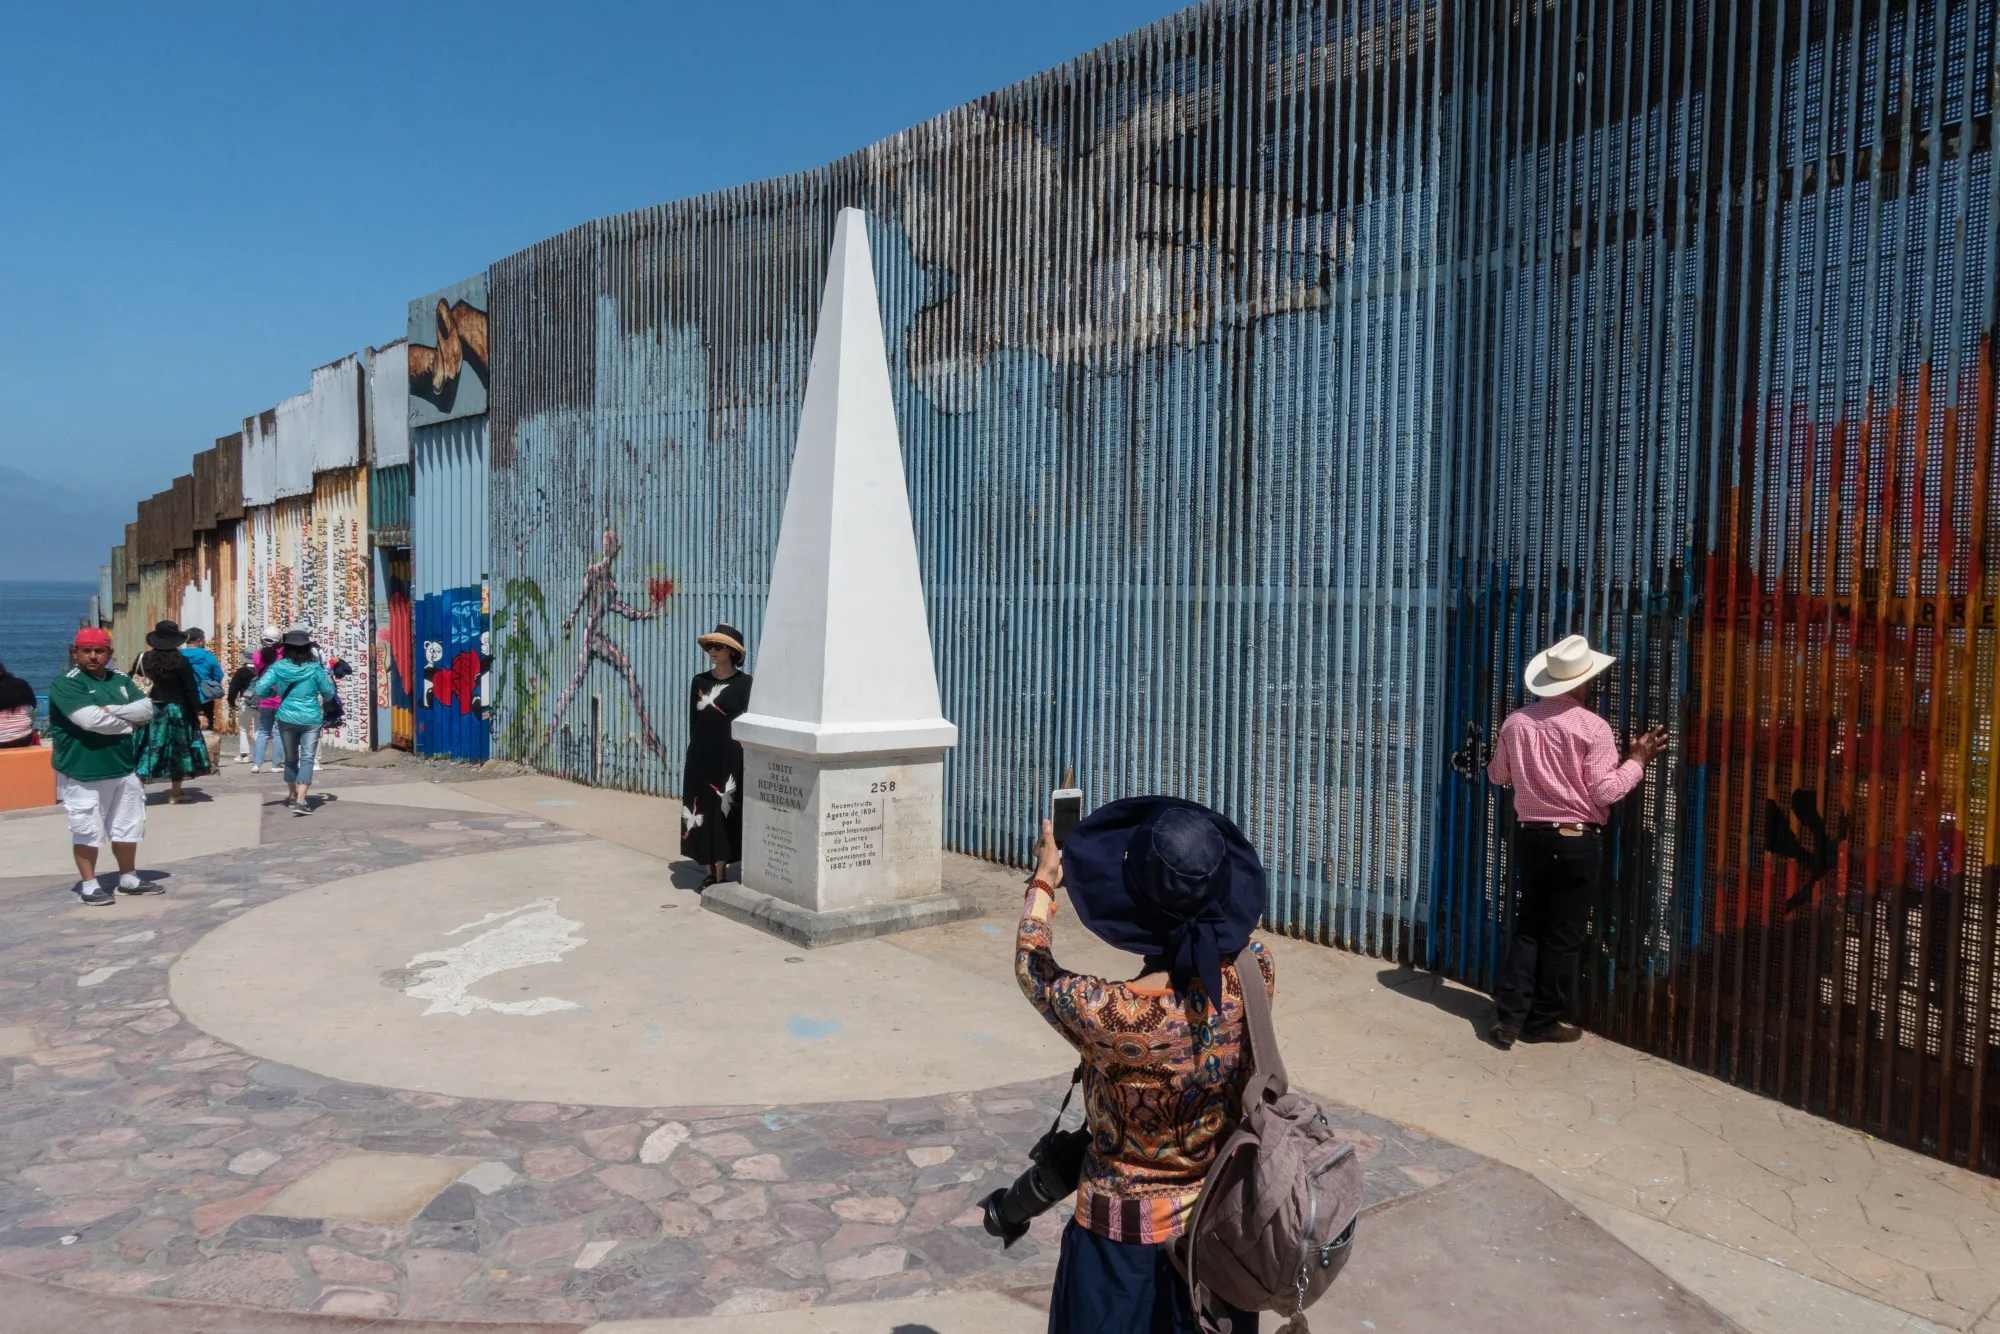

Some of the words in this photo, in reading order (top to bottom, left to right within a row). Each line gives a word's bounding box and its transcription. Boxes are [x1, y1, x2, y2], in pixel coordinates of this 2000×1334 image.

[1922, 601, 1995, 624] ARE
[359, 650, 368, 667] USN
[359, 672, 368, 717] MURILLO
[359, 718, 369, 745] ALEX
[870, 781, 897, 794] 258
[759, 791, 802, 810] MEXICANA
[831, 800, 873, 810] Reconstruido
[826, 812, 849, 821] Agosto
[860, 807, 877, 815] 1894
[846, 824, 882, 834] Internacional
[825, 853, 866, 863] Convenciones
[830, 862, 847, 870] 1882
[855, 859, 871, 867] 1889
